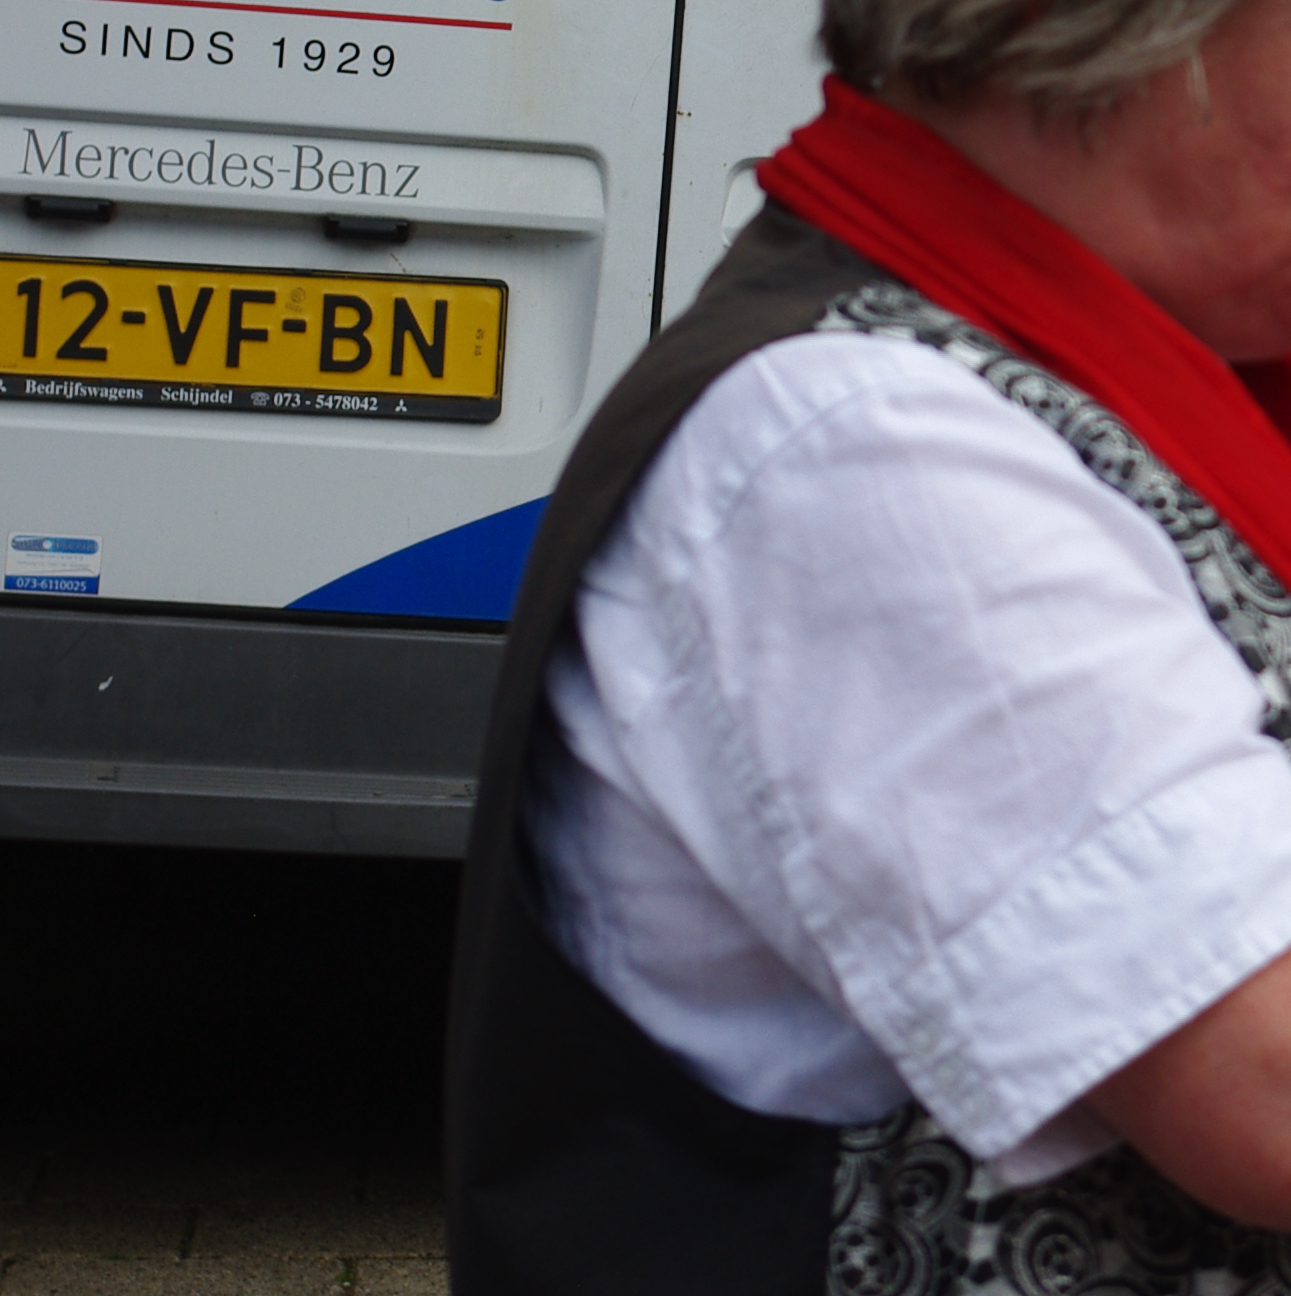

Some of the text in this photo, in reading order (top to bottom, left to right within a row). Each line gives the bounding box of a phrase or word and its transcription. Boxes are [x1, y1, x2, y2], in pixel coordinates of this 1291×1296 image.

[58, 20, 396, 77] SINDS 1929
[17, 128, 421, 200] Mercedes-Benz
[15, 277, 449, 379] 12-VF-BN
[25, 379, 144, 401] Bedrijfswagens
[160, 386, 233, 405] Schijndel
[273, 392, 301, 407] 073
[314, 394, 379, 411] 5478042
[16, 577, 87, 592] 073-6110025
